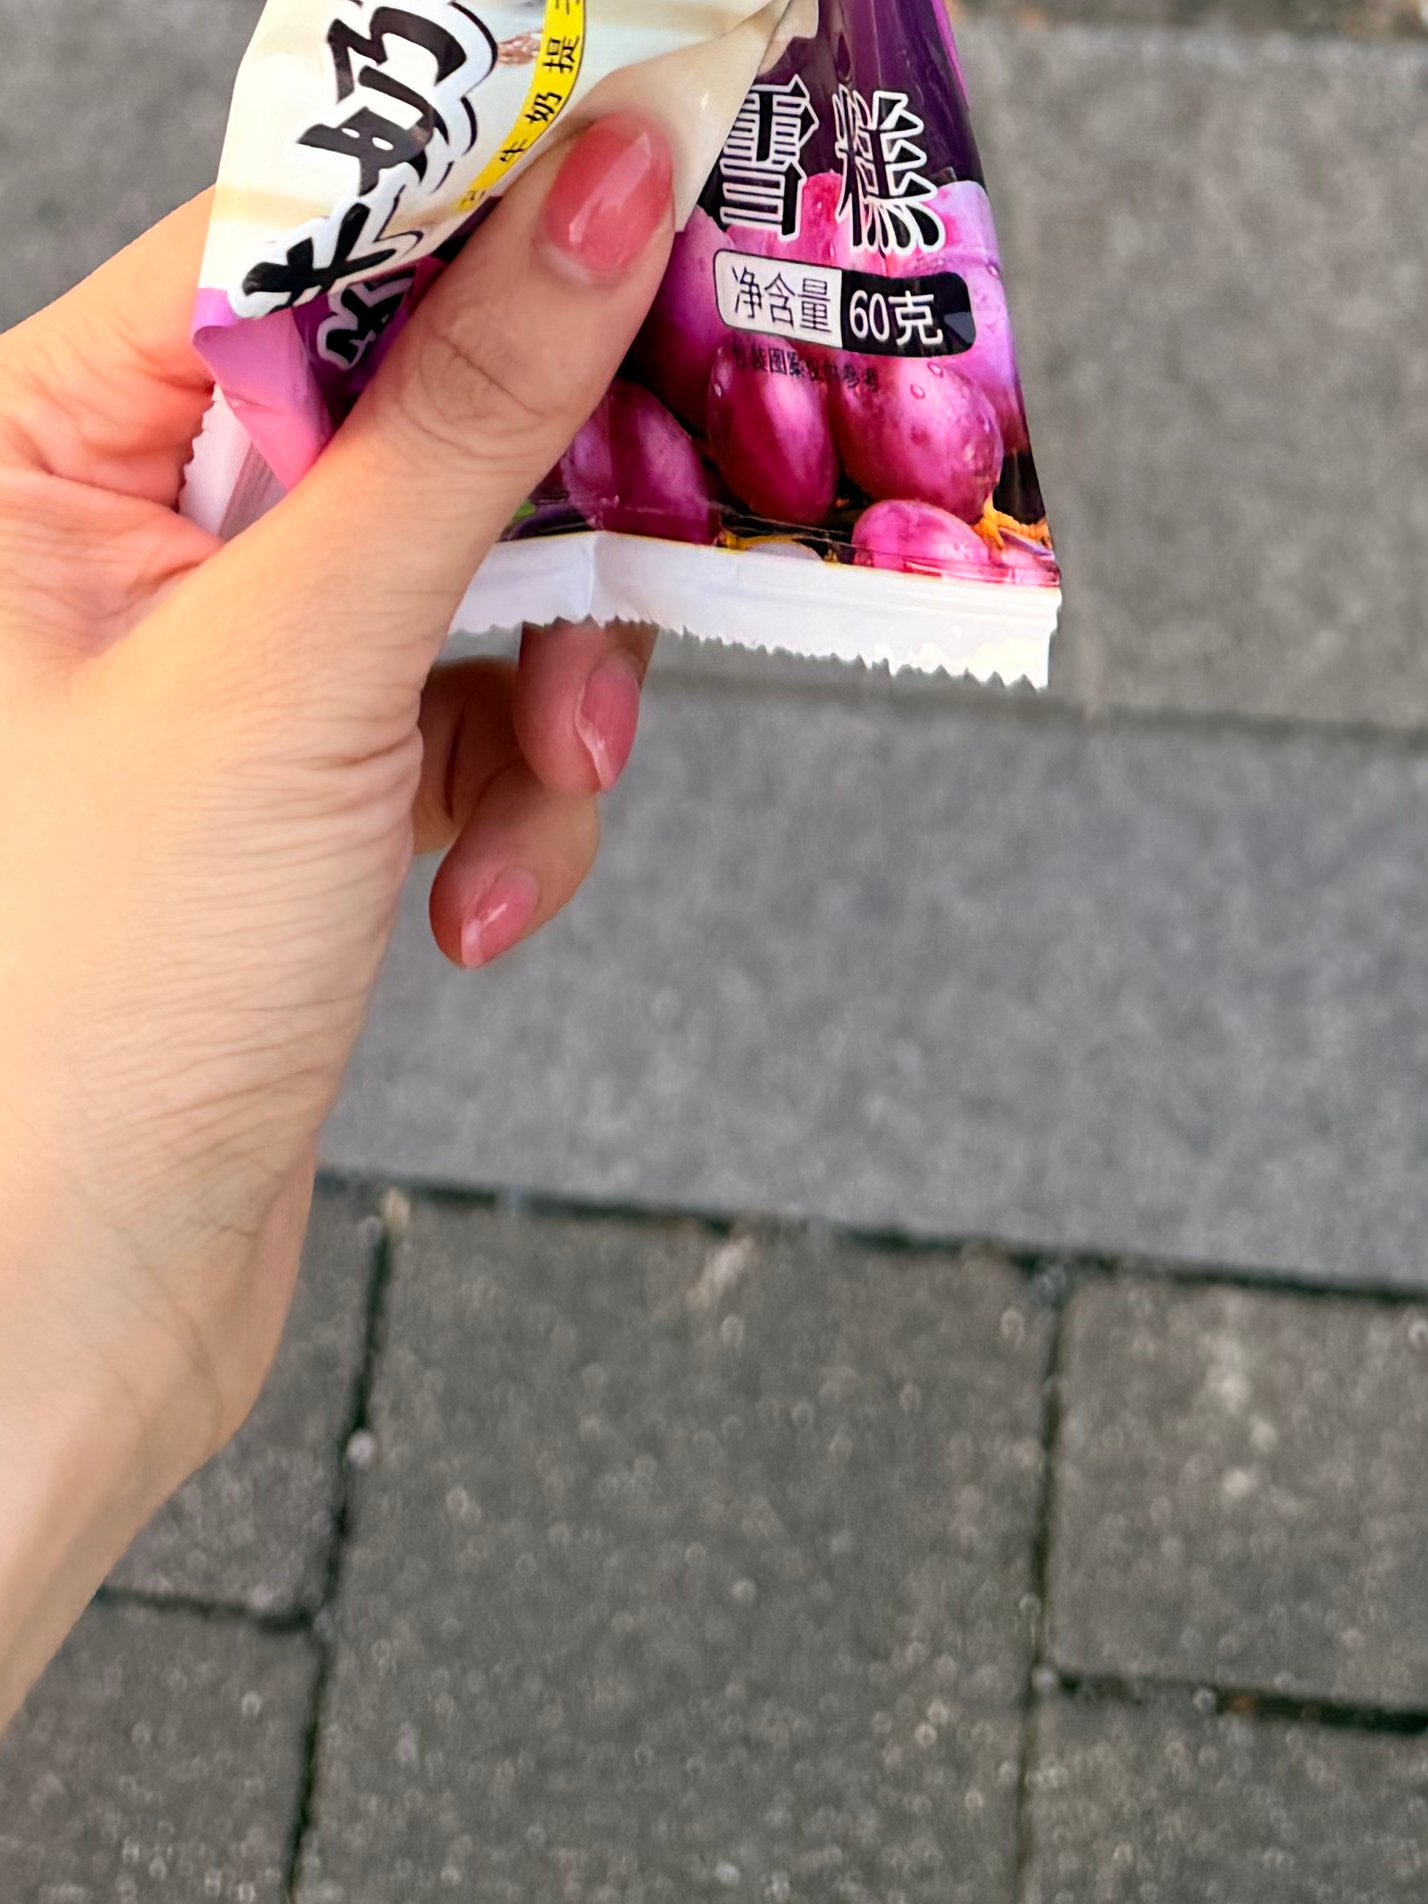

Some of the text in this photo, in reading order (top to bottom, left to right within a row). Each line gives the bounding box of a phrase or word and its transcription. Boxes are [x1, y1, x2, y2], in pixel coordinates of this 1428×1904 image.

[721, 73, 946, 255] 雪糕
[731, 266, 943, 345] 净含量 60克
